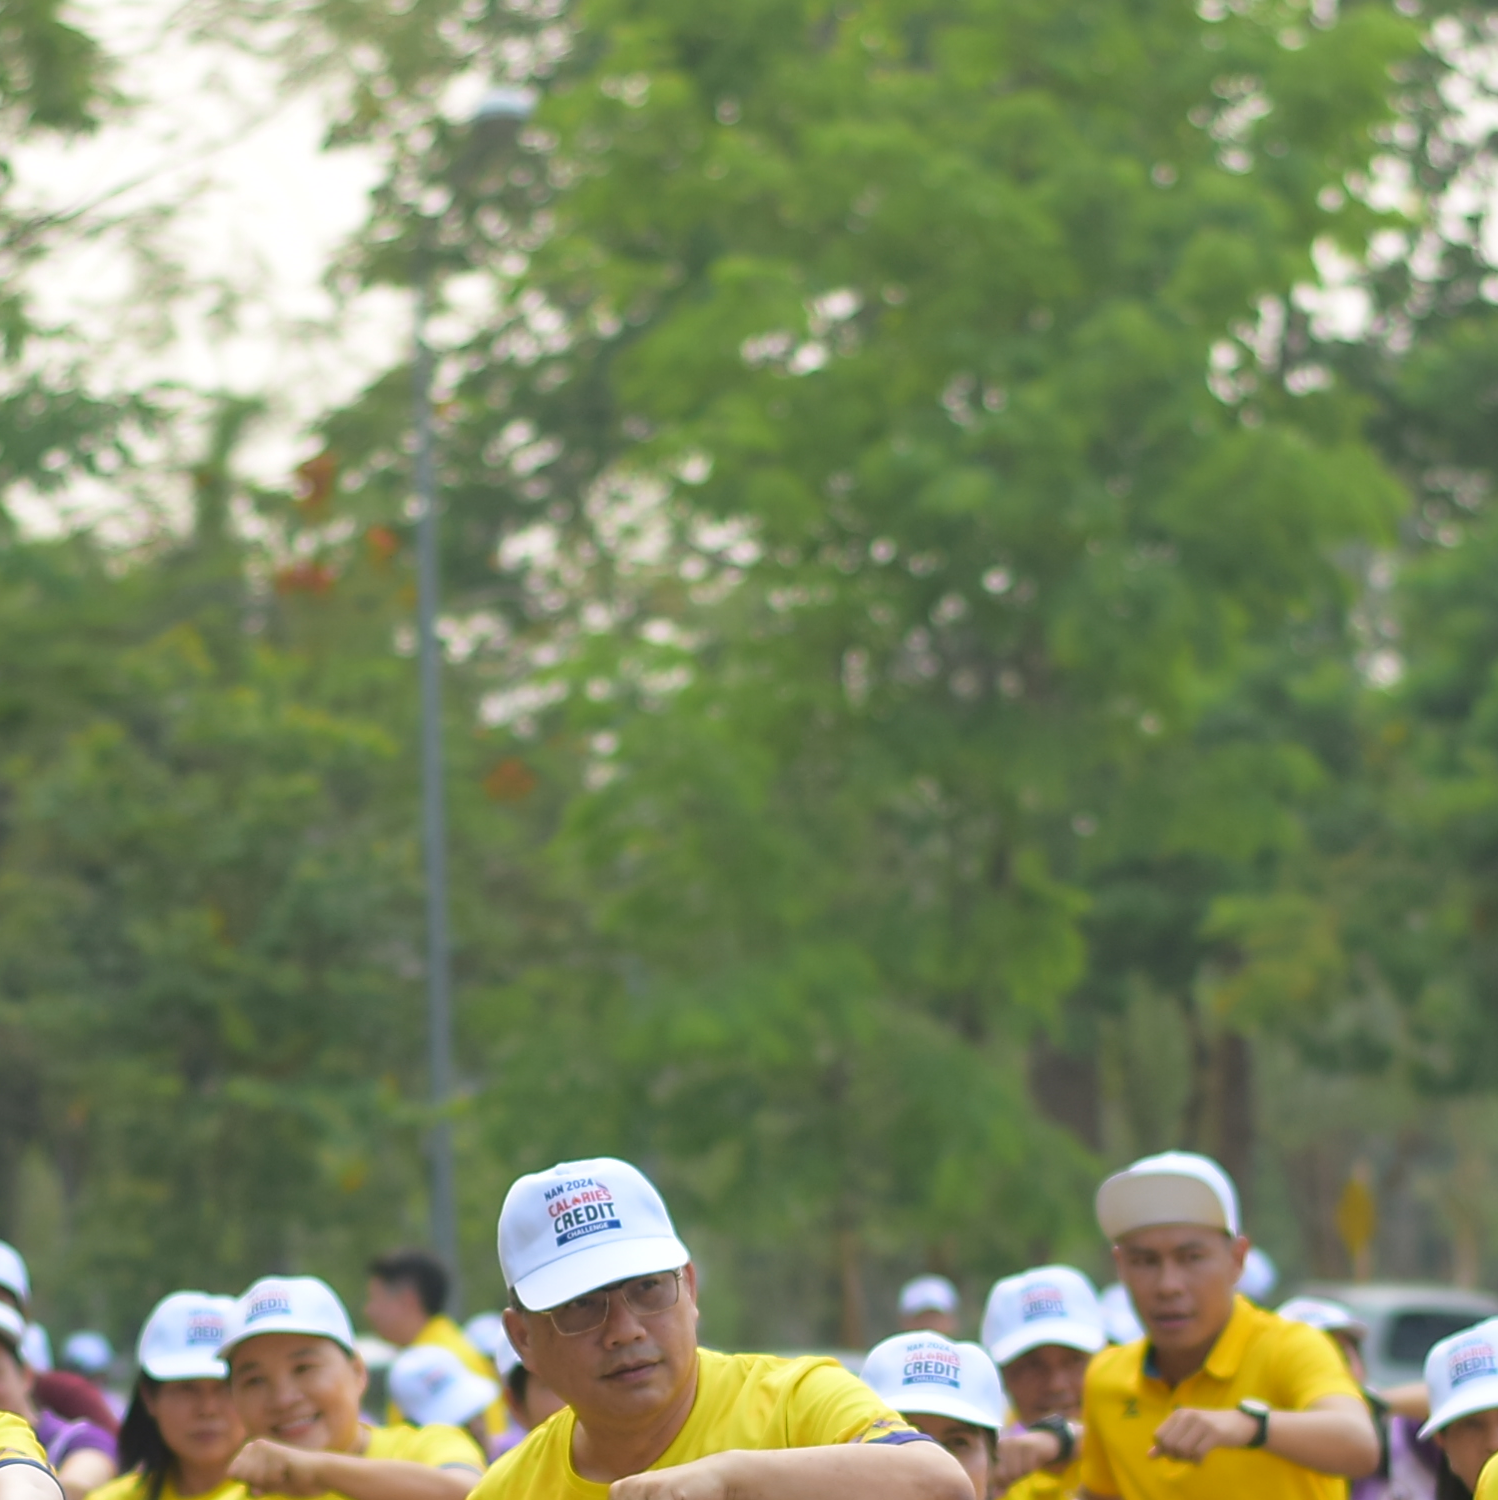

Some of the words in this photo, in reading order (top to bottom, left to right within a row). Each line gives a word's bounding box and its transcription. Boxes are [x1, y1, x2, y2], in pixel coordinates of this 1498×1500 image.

[543, 1186, 564, 1202] NAN
[566, 1178, 594, 1192] 2024
[553, 1202, 616, 1234] CREDIT
[566, 1222, 610, 1240] CHALLENGE
[187, 1326, 225, 1339] CREDI
[903, 1361, 960, 1379] CREDIT
[1450, 1355, 1496, 1379] CREDIT
